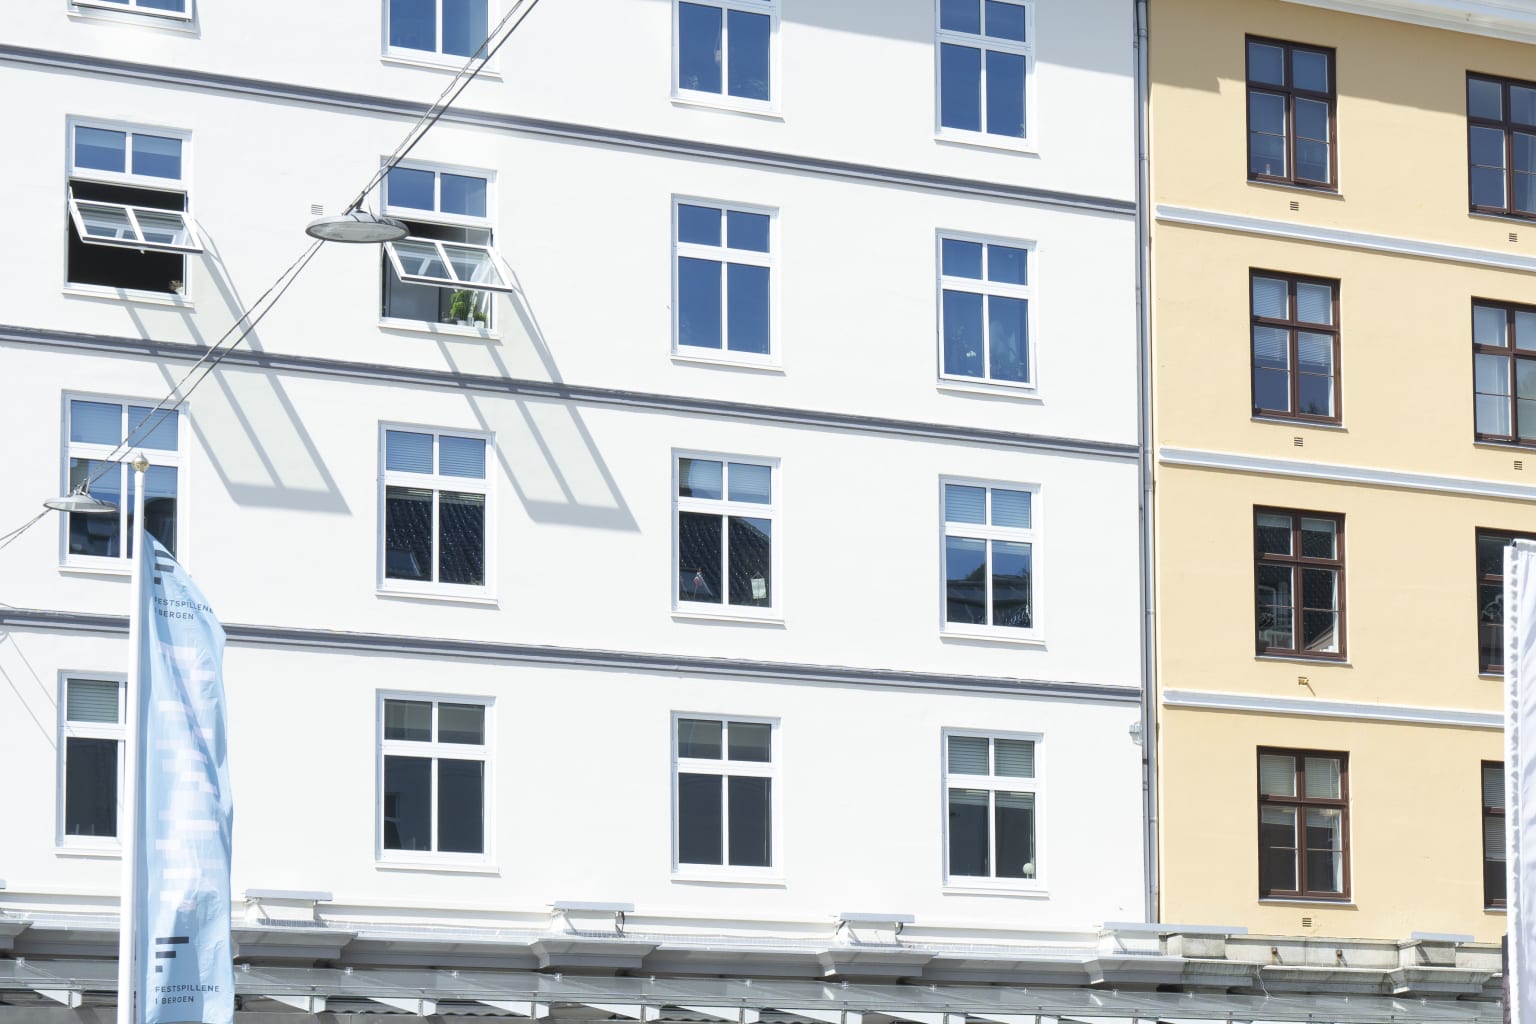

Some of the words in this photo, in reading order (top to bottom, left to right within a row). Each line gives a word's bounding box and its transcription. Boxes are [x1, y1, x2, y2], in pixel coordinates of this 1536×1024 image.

[158, 609, 194, 620] BERGEN
[155, 984, 221, 993] FESTSPILLENE
[162, 996, 194, 1005] BERGEN
